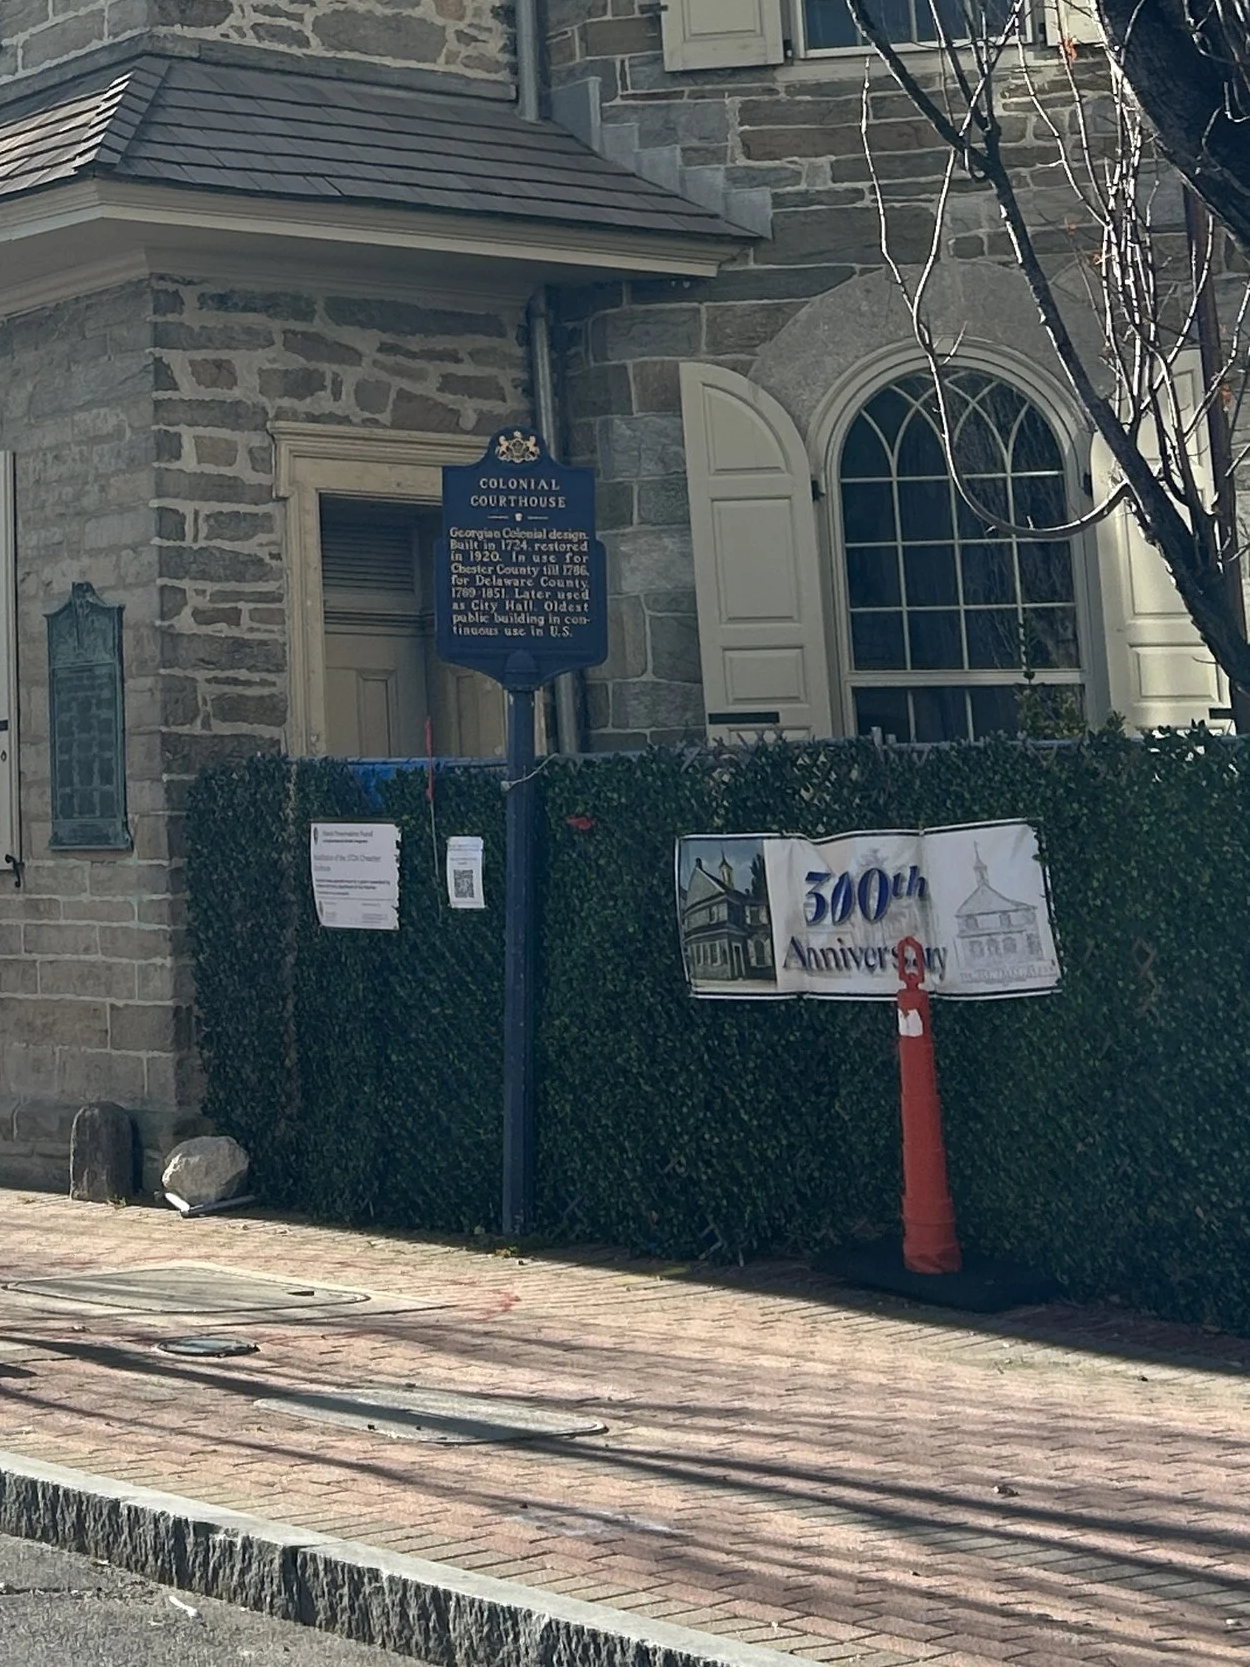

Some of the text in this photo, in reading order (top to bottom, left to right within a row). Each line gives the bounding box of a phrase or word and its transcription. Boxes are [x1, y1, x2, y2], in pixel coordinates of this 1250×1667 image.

[480, 478, 560, 490] COLONIAL
[471, 496, 566, 508] COURTHOUSE
[450, 527, 500, 540] Georgian
[502, 527, 546, 539] Colonial
[450, 540, 478, 550] Built
[484, 540, 496, 550] in
[534, 541, 588, 552] restored
[512, 552, 525, 562] In
[533, 554, 556, 562] use
[565, 552, 589, 563] for
[451, 563, 494, 574] Chester
[496, 565, 540, 577] County
[451, 575, 469, 586] for
[476, 575, 534, 586] Delaware
[514, 588, 551, 599] Later
[557, 589, 590, 600] used
[452, 602, 465, 611] as
[471, 600, 498, 614] City
[544, 601, 589, 613] Oldest
[452, 613, 490, 625] public
[494, 613, 545, 626] building
[549, 614, 561, 624] in
[453, 625, 573, 638] tinuous use in U.S.
[804, 865, 927, 926] 300th
